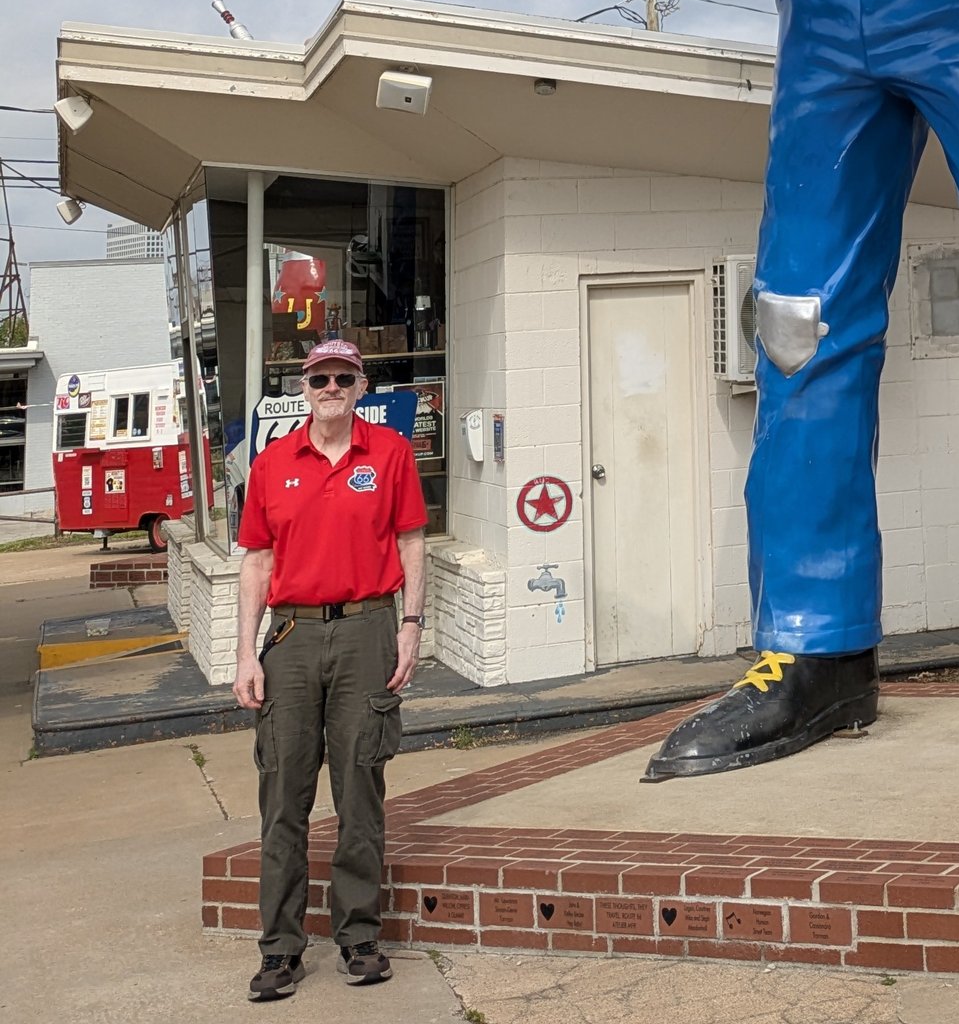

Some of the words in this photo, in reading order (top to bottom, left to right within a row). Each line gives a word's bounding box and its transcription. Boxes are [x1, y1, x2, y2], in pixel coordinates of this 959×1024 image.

[264, 400, 305, 415] ROUTE
[354, 405, 387, 424] SIDE
[413, 420, 437, 428] ATEST
[356, 474, 371, 484] 66
[809, 911, 825, 919] Gordon
